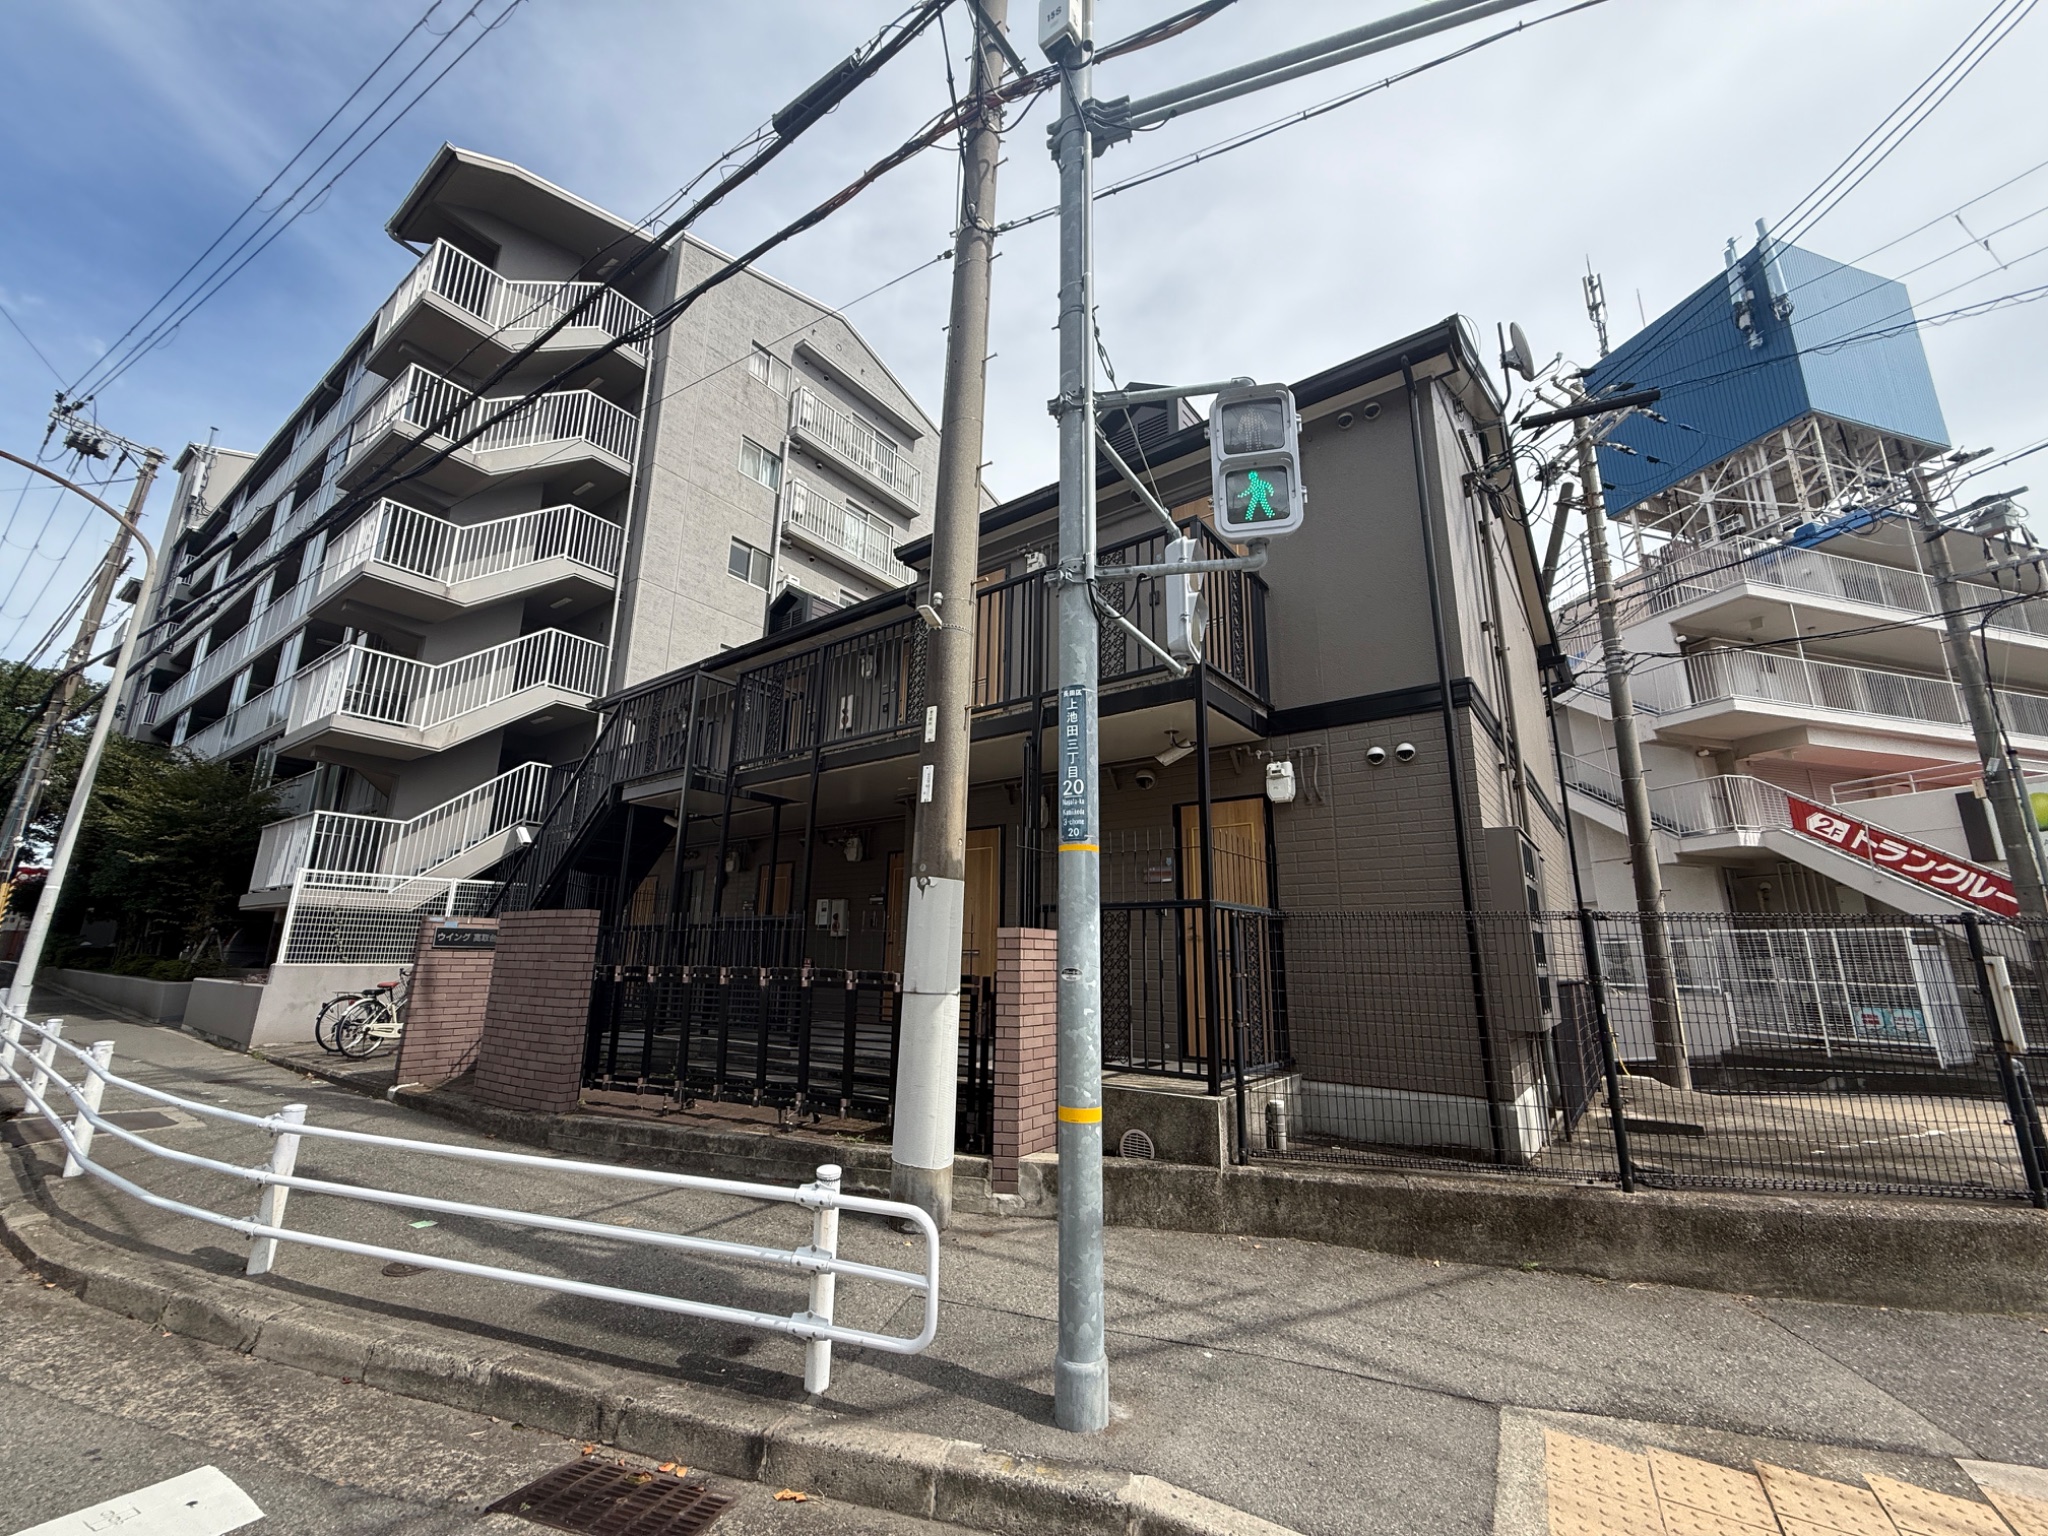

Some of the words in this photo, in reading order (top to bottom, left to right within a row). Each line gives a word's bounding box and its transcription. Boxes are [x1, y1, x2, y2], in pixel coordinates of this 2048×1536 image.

[1066, 697, 1079, 778] 上池田三丁目
[1063, 779, 1084, 796] 20
[1067, 827, 1080, 837] 20
[1814, 817, 1844, 837] 2F
[1851, 829, 2020, 916] トランクルー
